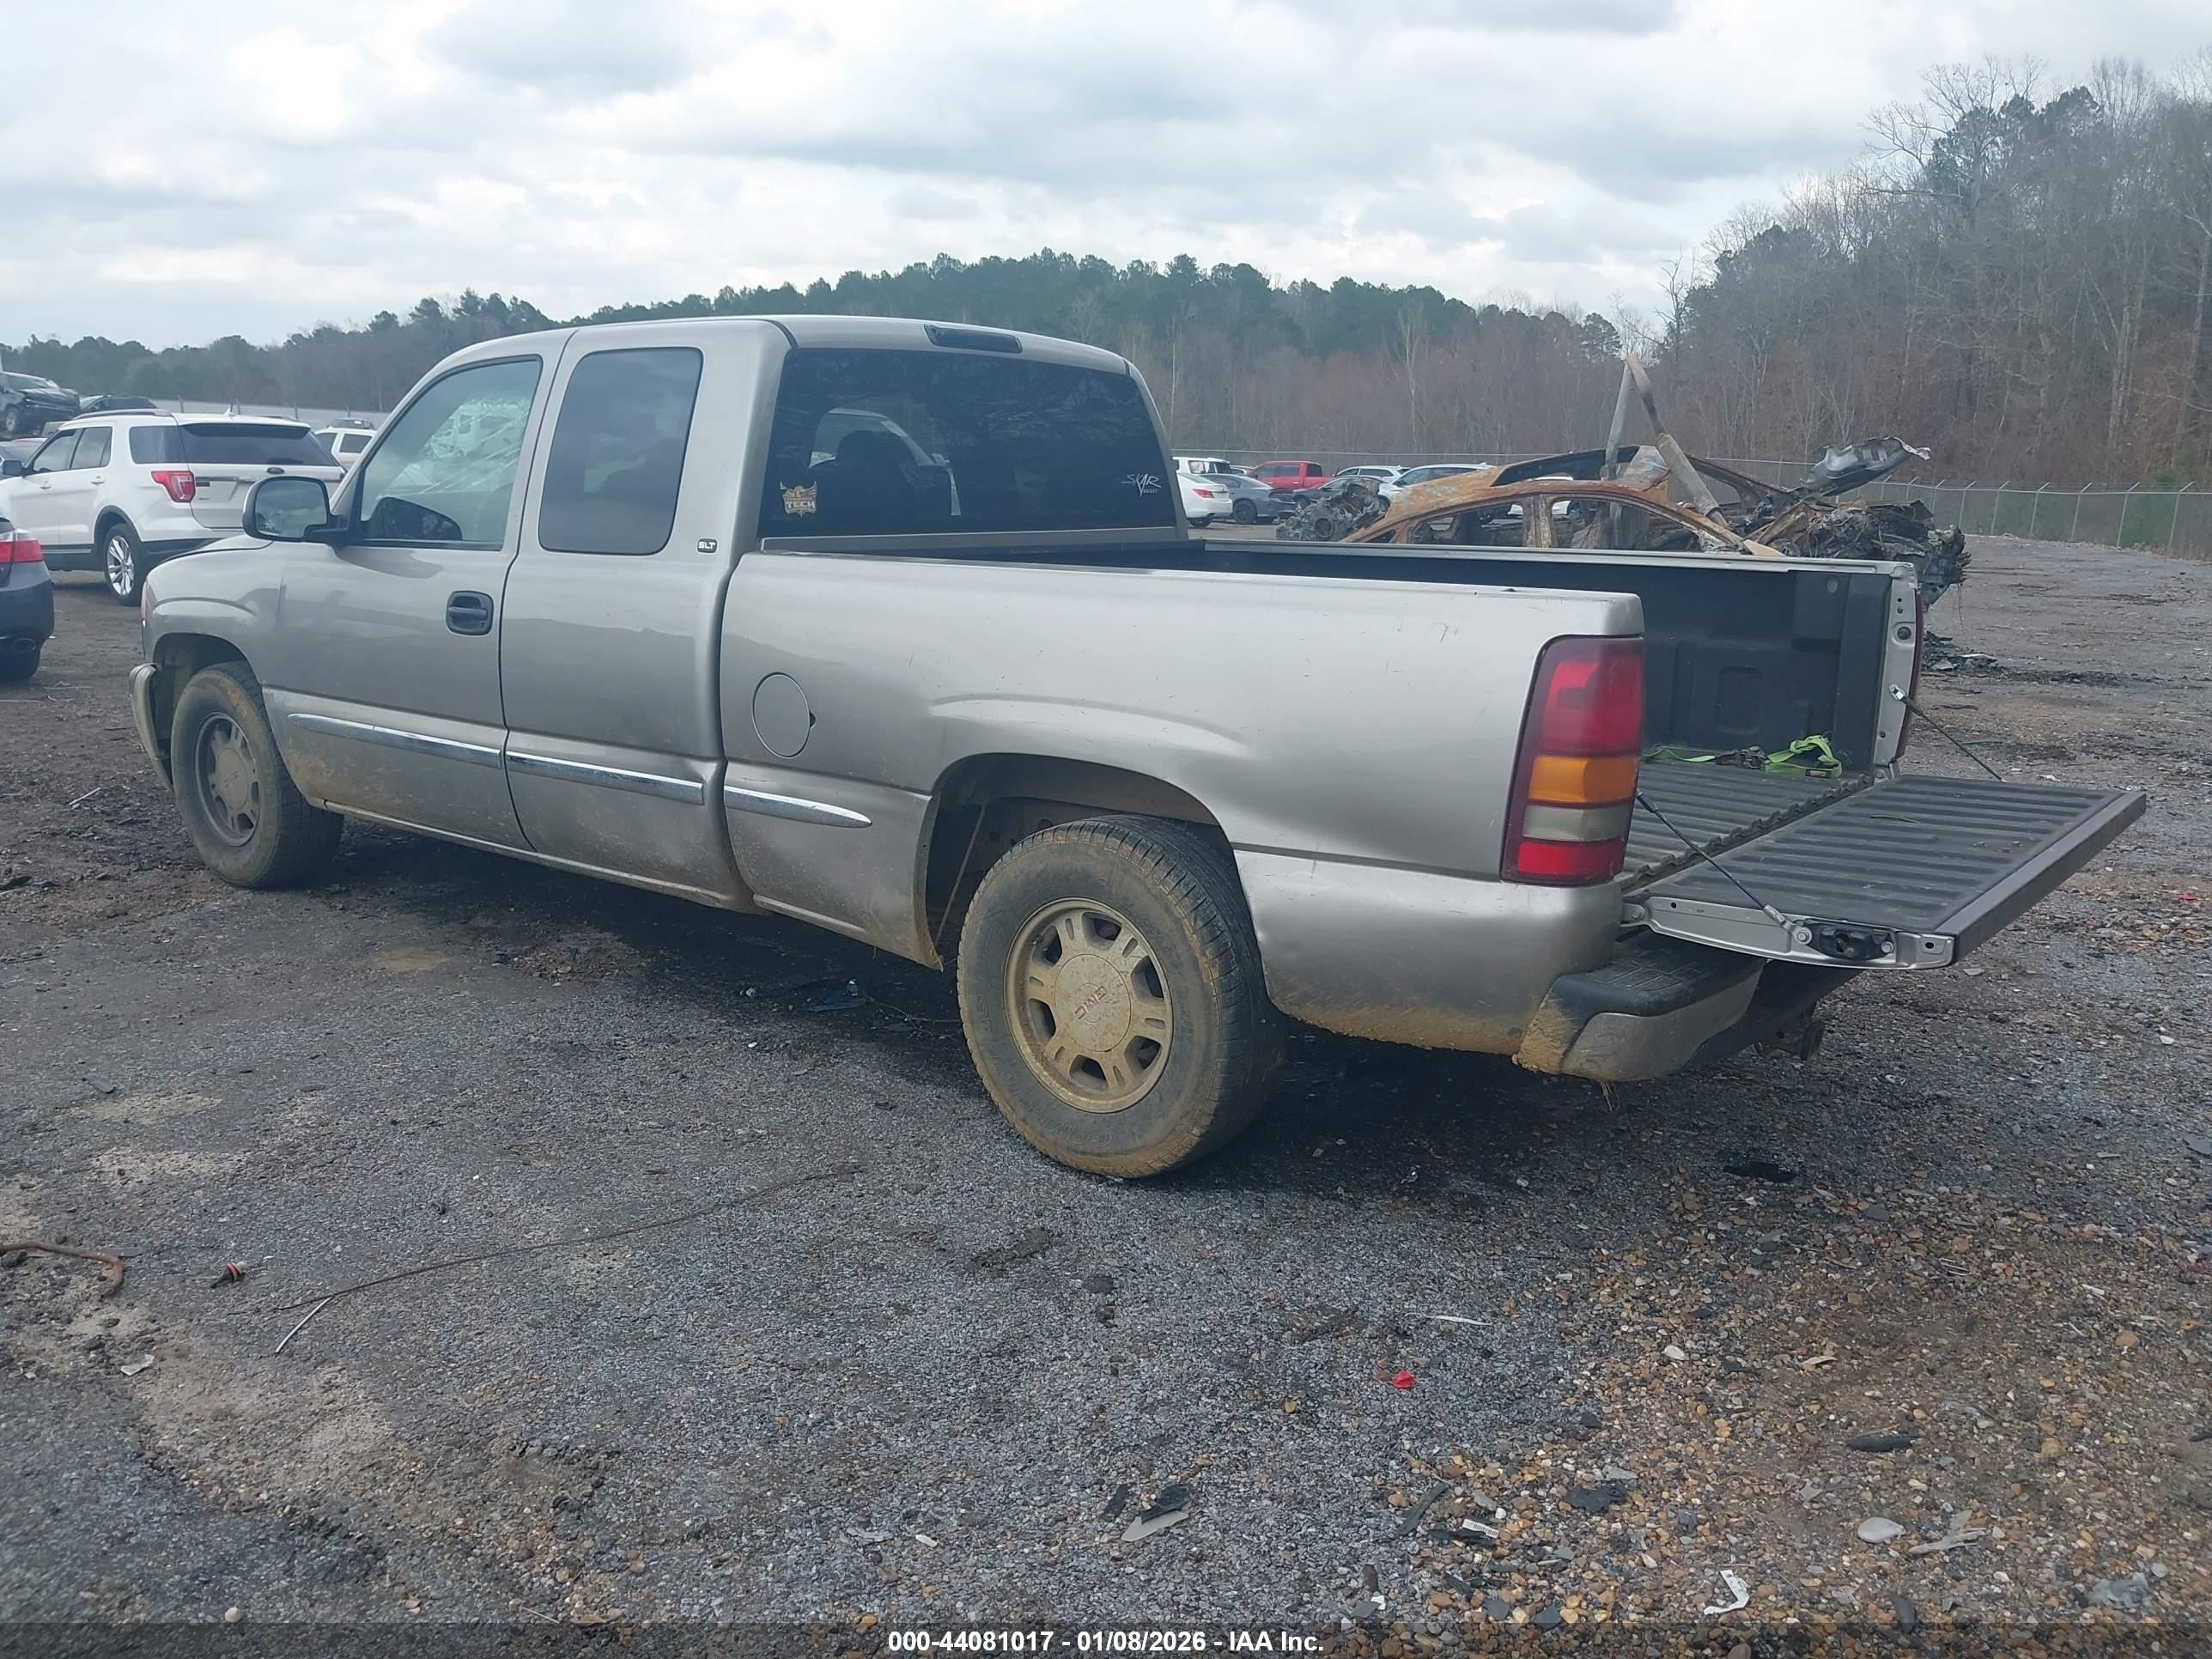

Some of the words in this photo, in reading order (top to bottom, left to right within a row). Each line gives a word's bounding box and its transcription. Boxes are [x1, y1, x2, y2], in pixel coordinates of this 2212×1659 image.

[785, 501, 816, 509] TECH
[698, 541, 716, 550] SLT
[1074, 985, 1107, 1021] GMC
